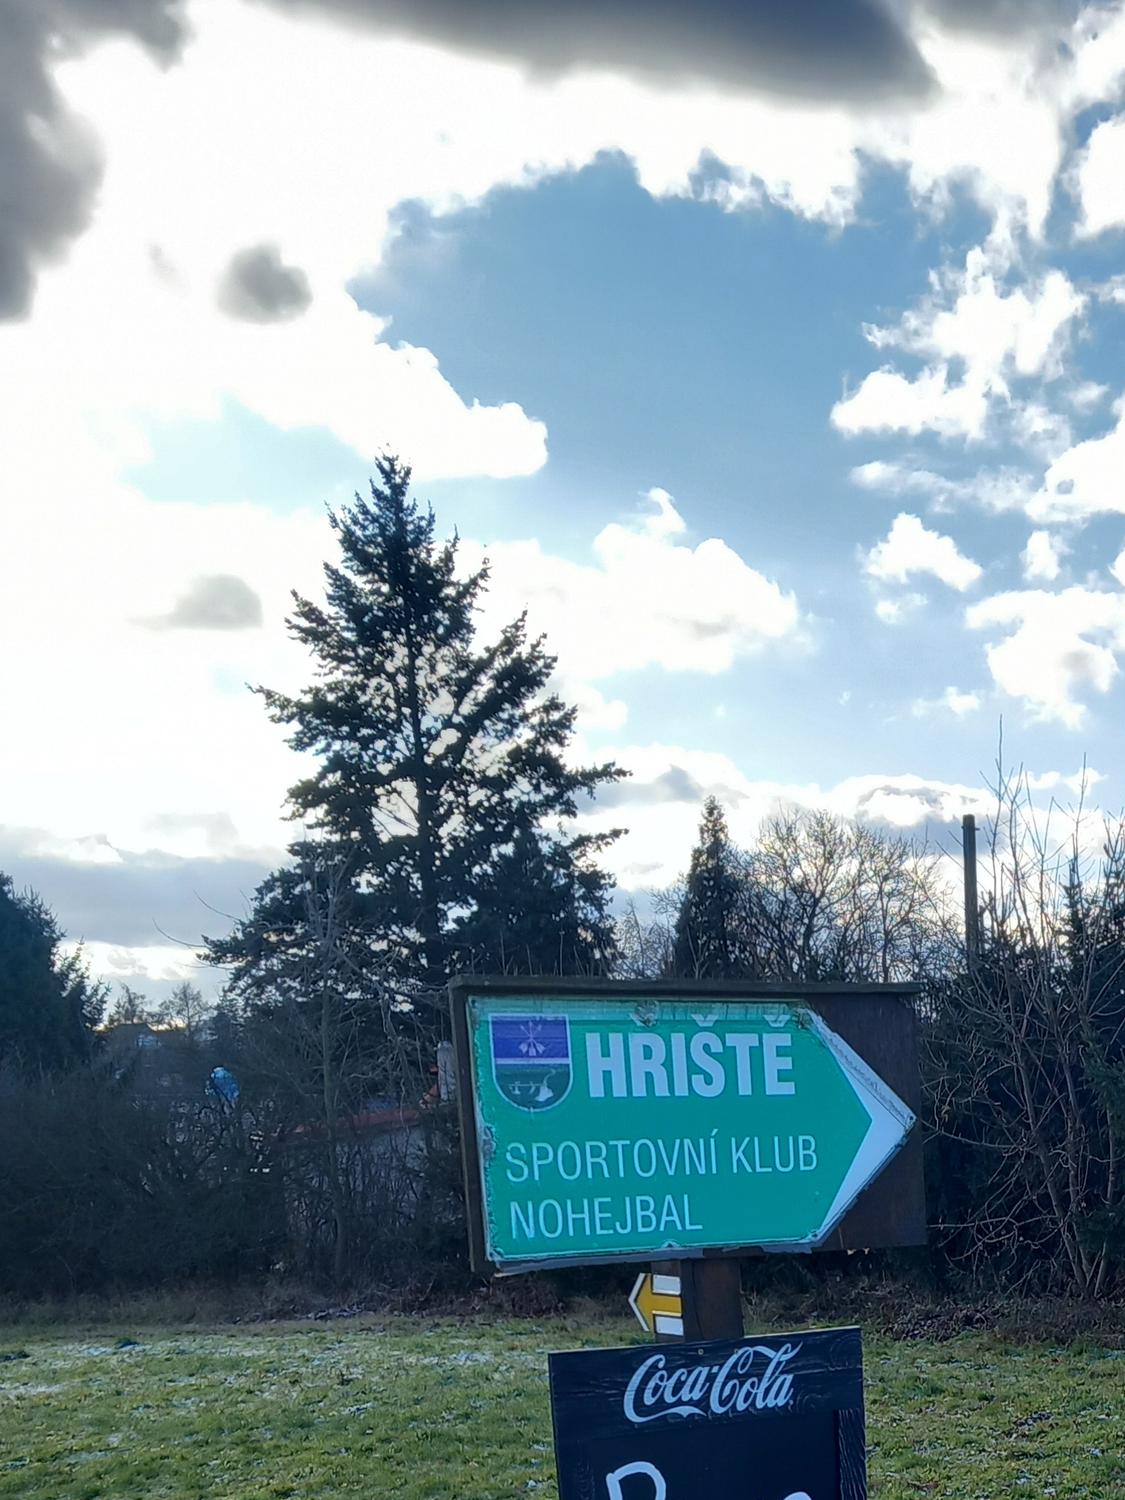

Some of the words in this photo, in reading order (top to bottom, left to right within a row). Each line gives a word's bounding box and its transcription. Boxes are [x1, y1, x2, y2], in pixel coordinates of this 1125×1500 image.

[505, 1129, 719, 1182] SPORTOVNÍ
[731, 1135, 818, 1174] KLUB
[510, 1194, 703, 1239] NOHEJBAL
